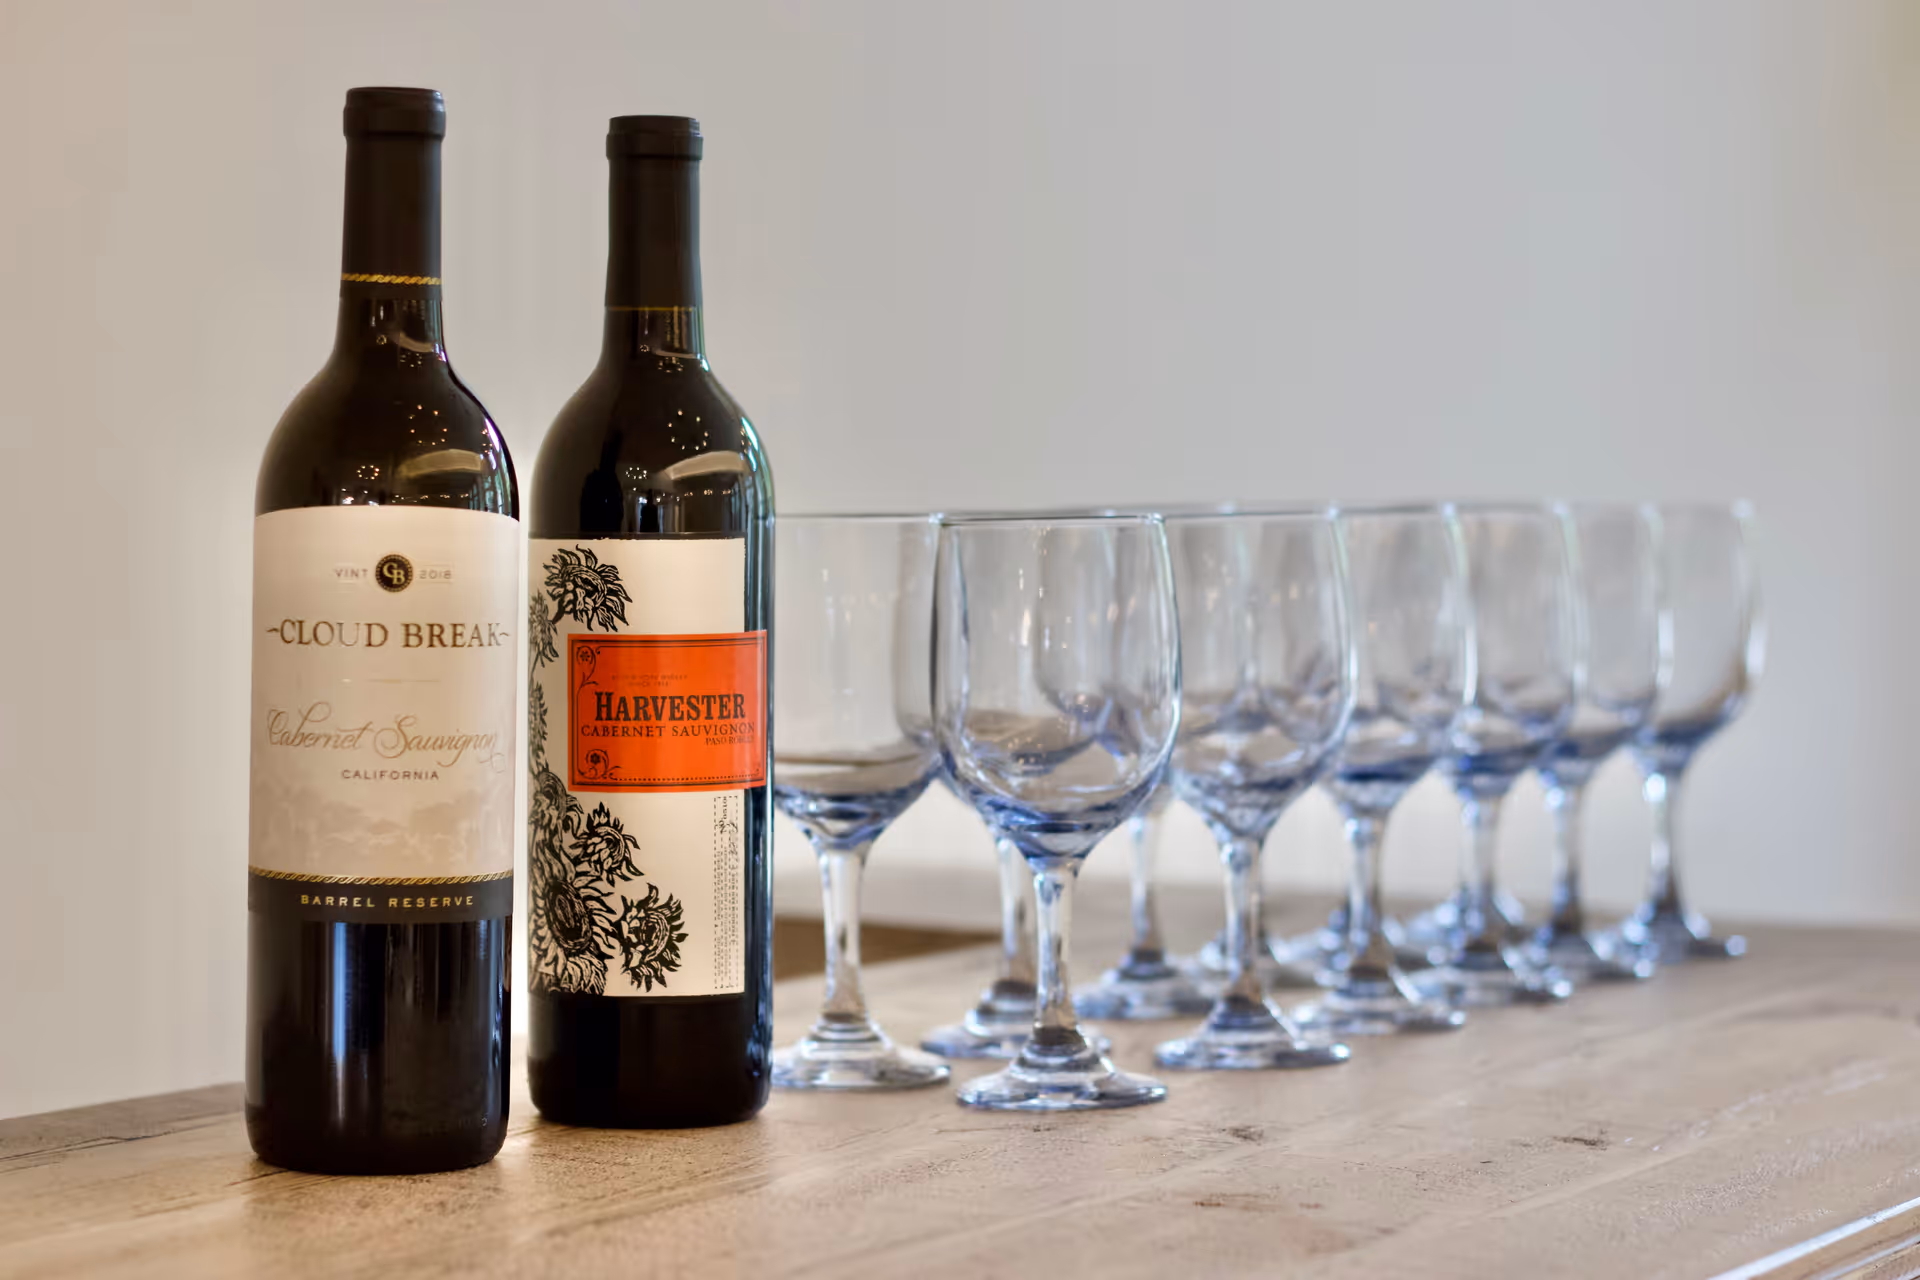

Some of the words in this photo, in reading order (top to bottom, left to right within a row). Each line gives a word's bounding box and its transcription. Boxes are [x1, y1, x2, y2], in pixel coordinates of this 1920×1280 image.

[334, 568, 368, 579] VINT
[279, 619, 389, 647] CLOUD
[401, 622, 502, 648] BREAK
[594, 691, 746, 722] HARVESTER
[267, 701, 375, 750] Cabernet
[374, 715, 501, 768] Sauvignon
[581, 724, 666, 738] CABERNET
[671, 722, 755, 737] SAUVIGNON
[341, 768, 440, 781] CALIFORNIA
[300, 894, 376, 908] BARREL
[388, 895, 474, 908] RESERVE
